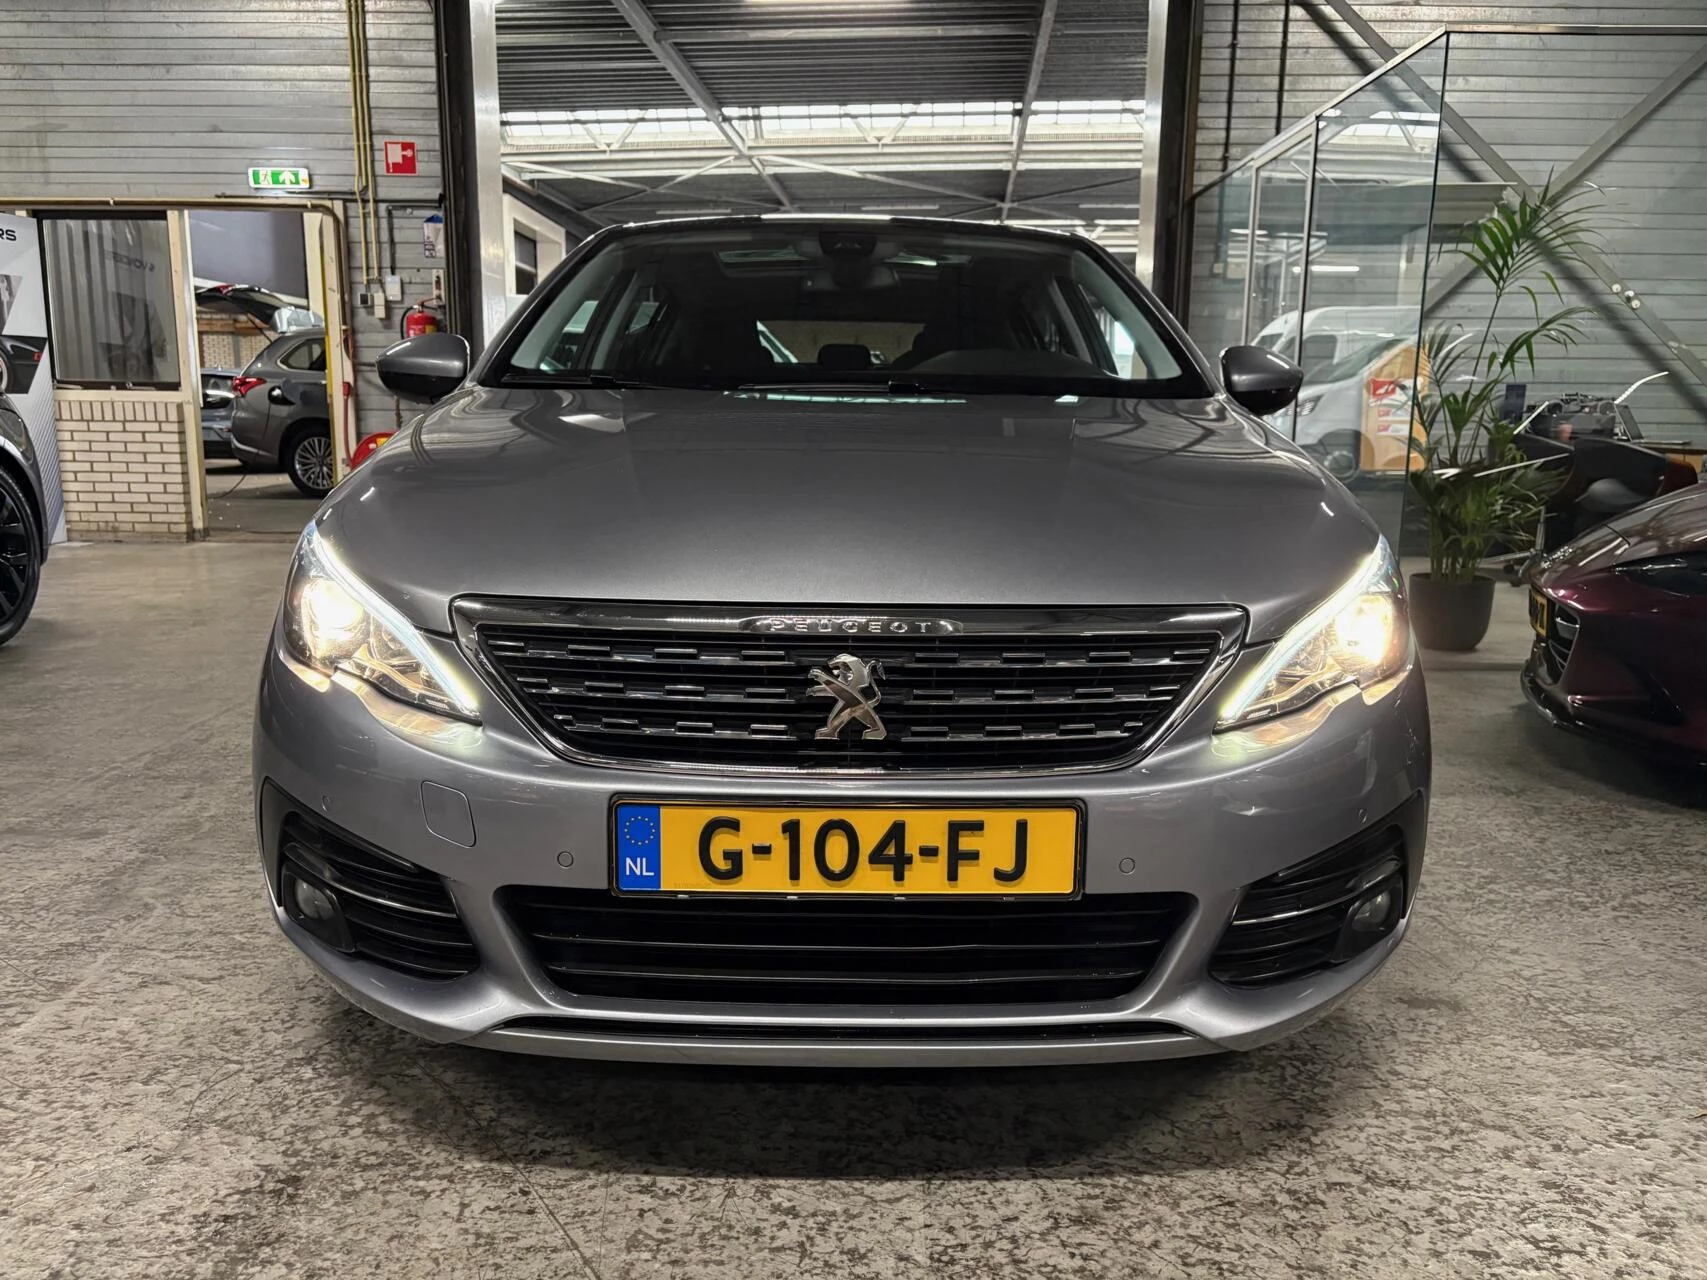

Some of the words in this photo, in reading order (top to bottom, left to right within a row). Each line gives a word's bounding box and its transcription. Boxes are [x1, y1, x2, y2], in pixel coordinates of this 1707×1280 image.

[769, 618, 931, 633] PEUGEOT
[697, 816, 1028, 882] G-104-FJ
[625, 857, 654, 876] NL
